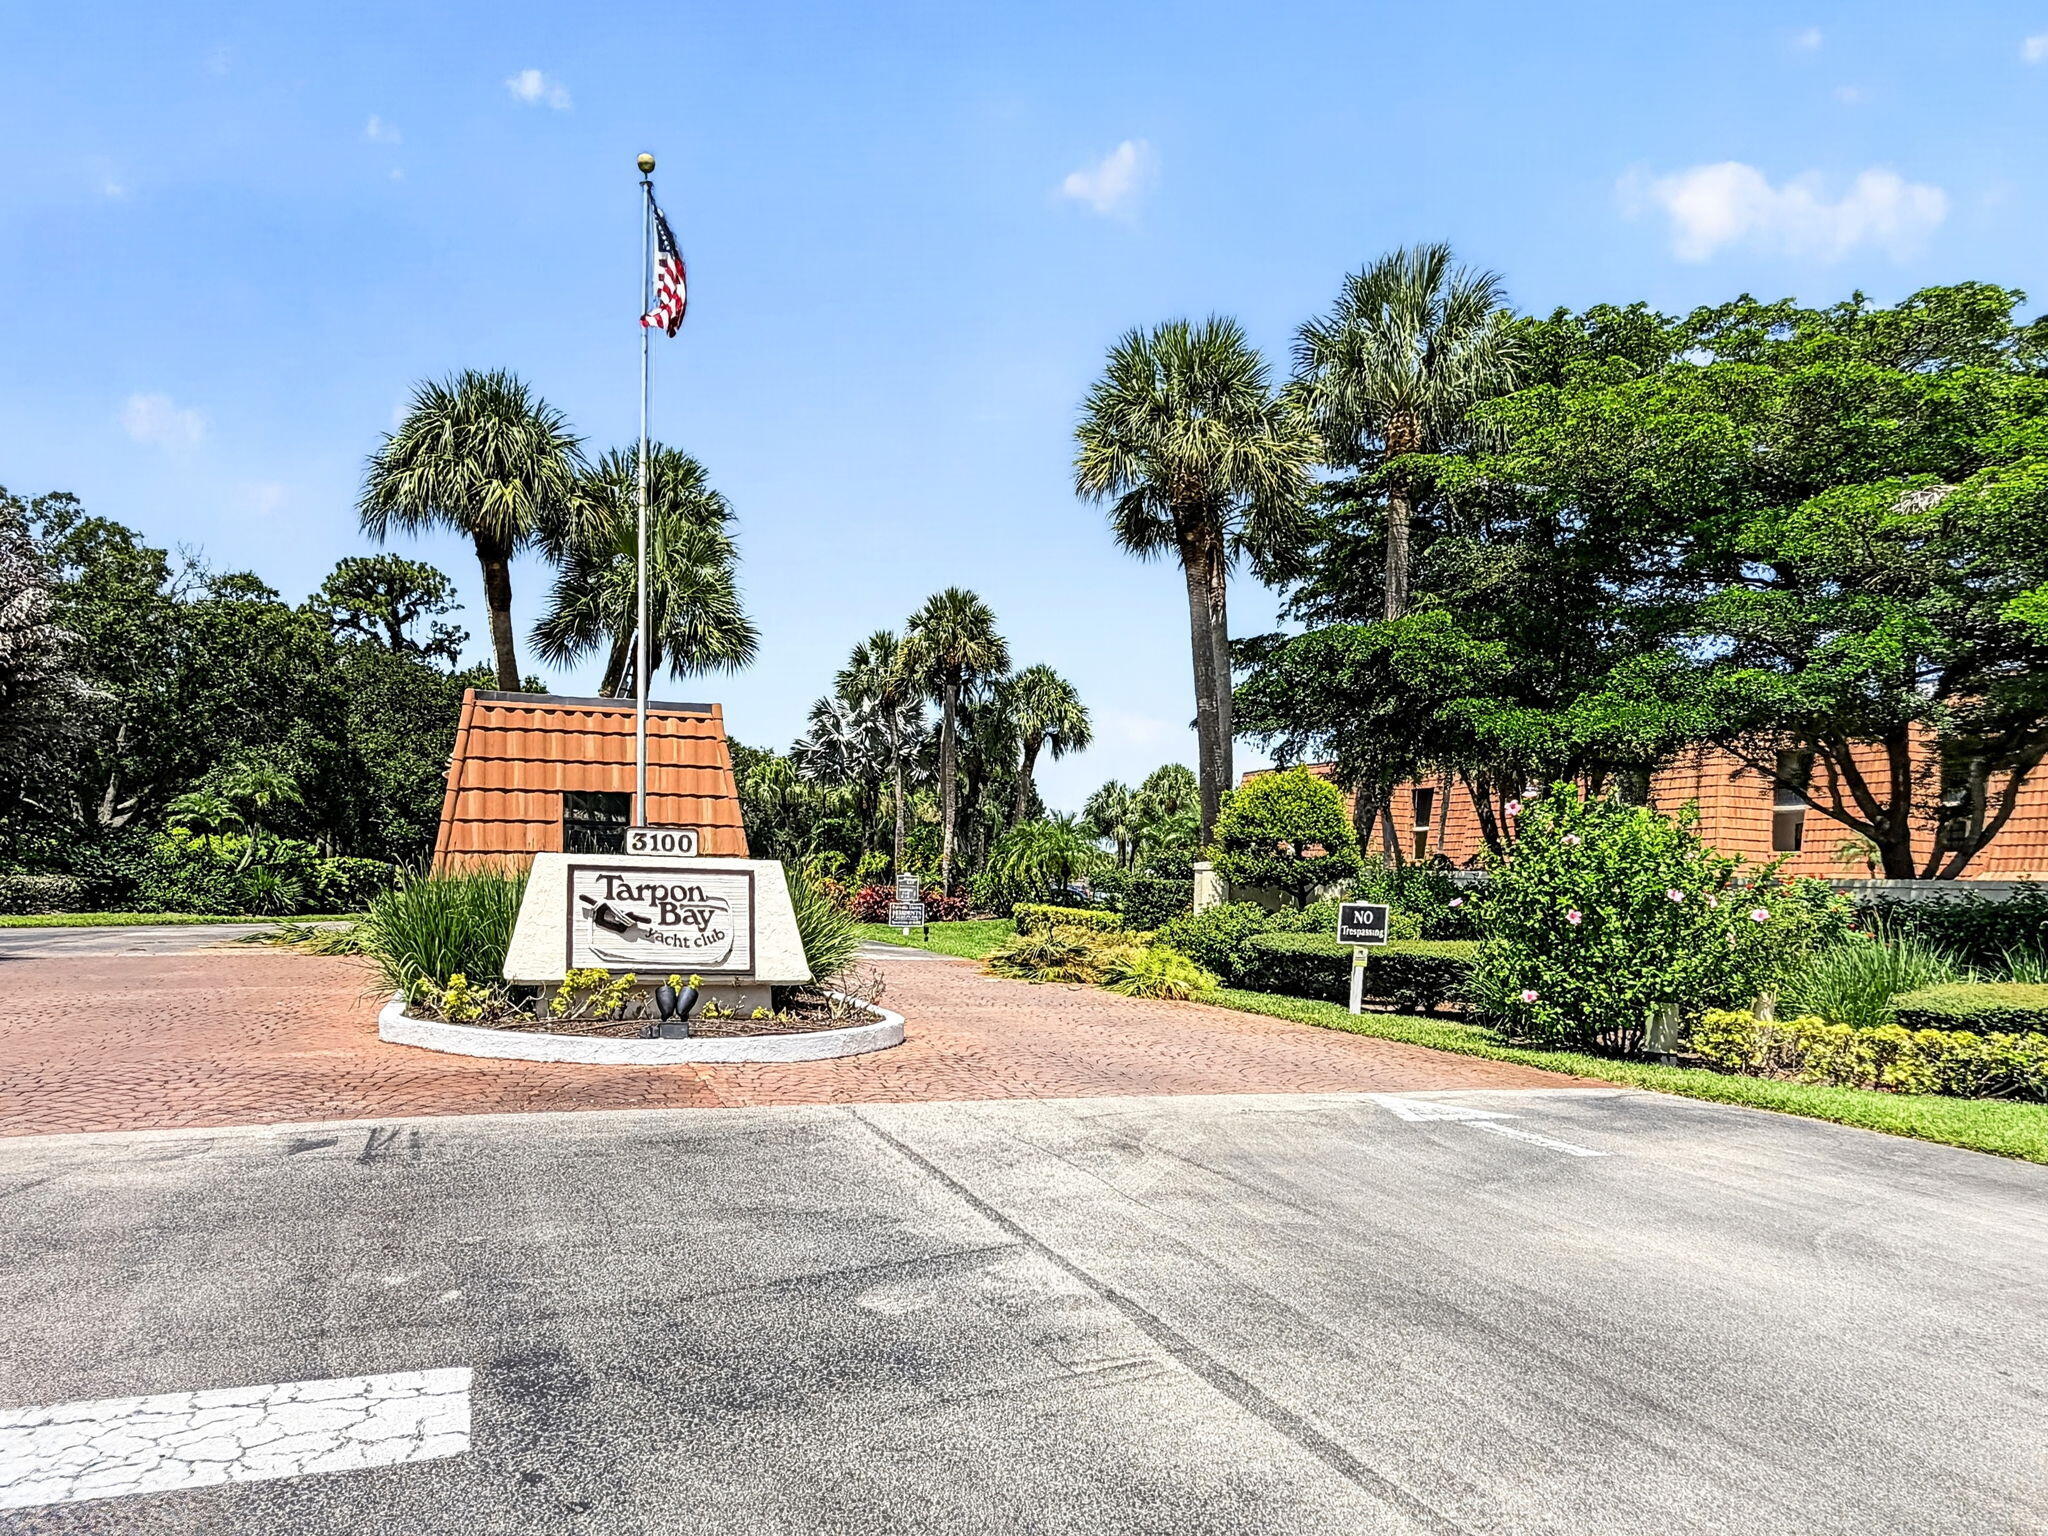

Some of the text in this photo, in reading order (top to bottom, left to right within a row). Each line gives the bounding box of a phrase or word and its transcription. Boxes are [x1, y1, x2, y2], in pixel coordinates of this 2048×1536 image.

[632, 833, 692, 853] 3100
[596, 874, 707, 907] Tarpon
[658, 902, 716, 932] Bay
[1353, 910, 1374, 924] NO
[694, 929, 725, 948] club
[1341, 925, 1384, 938] Trespassing
